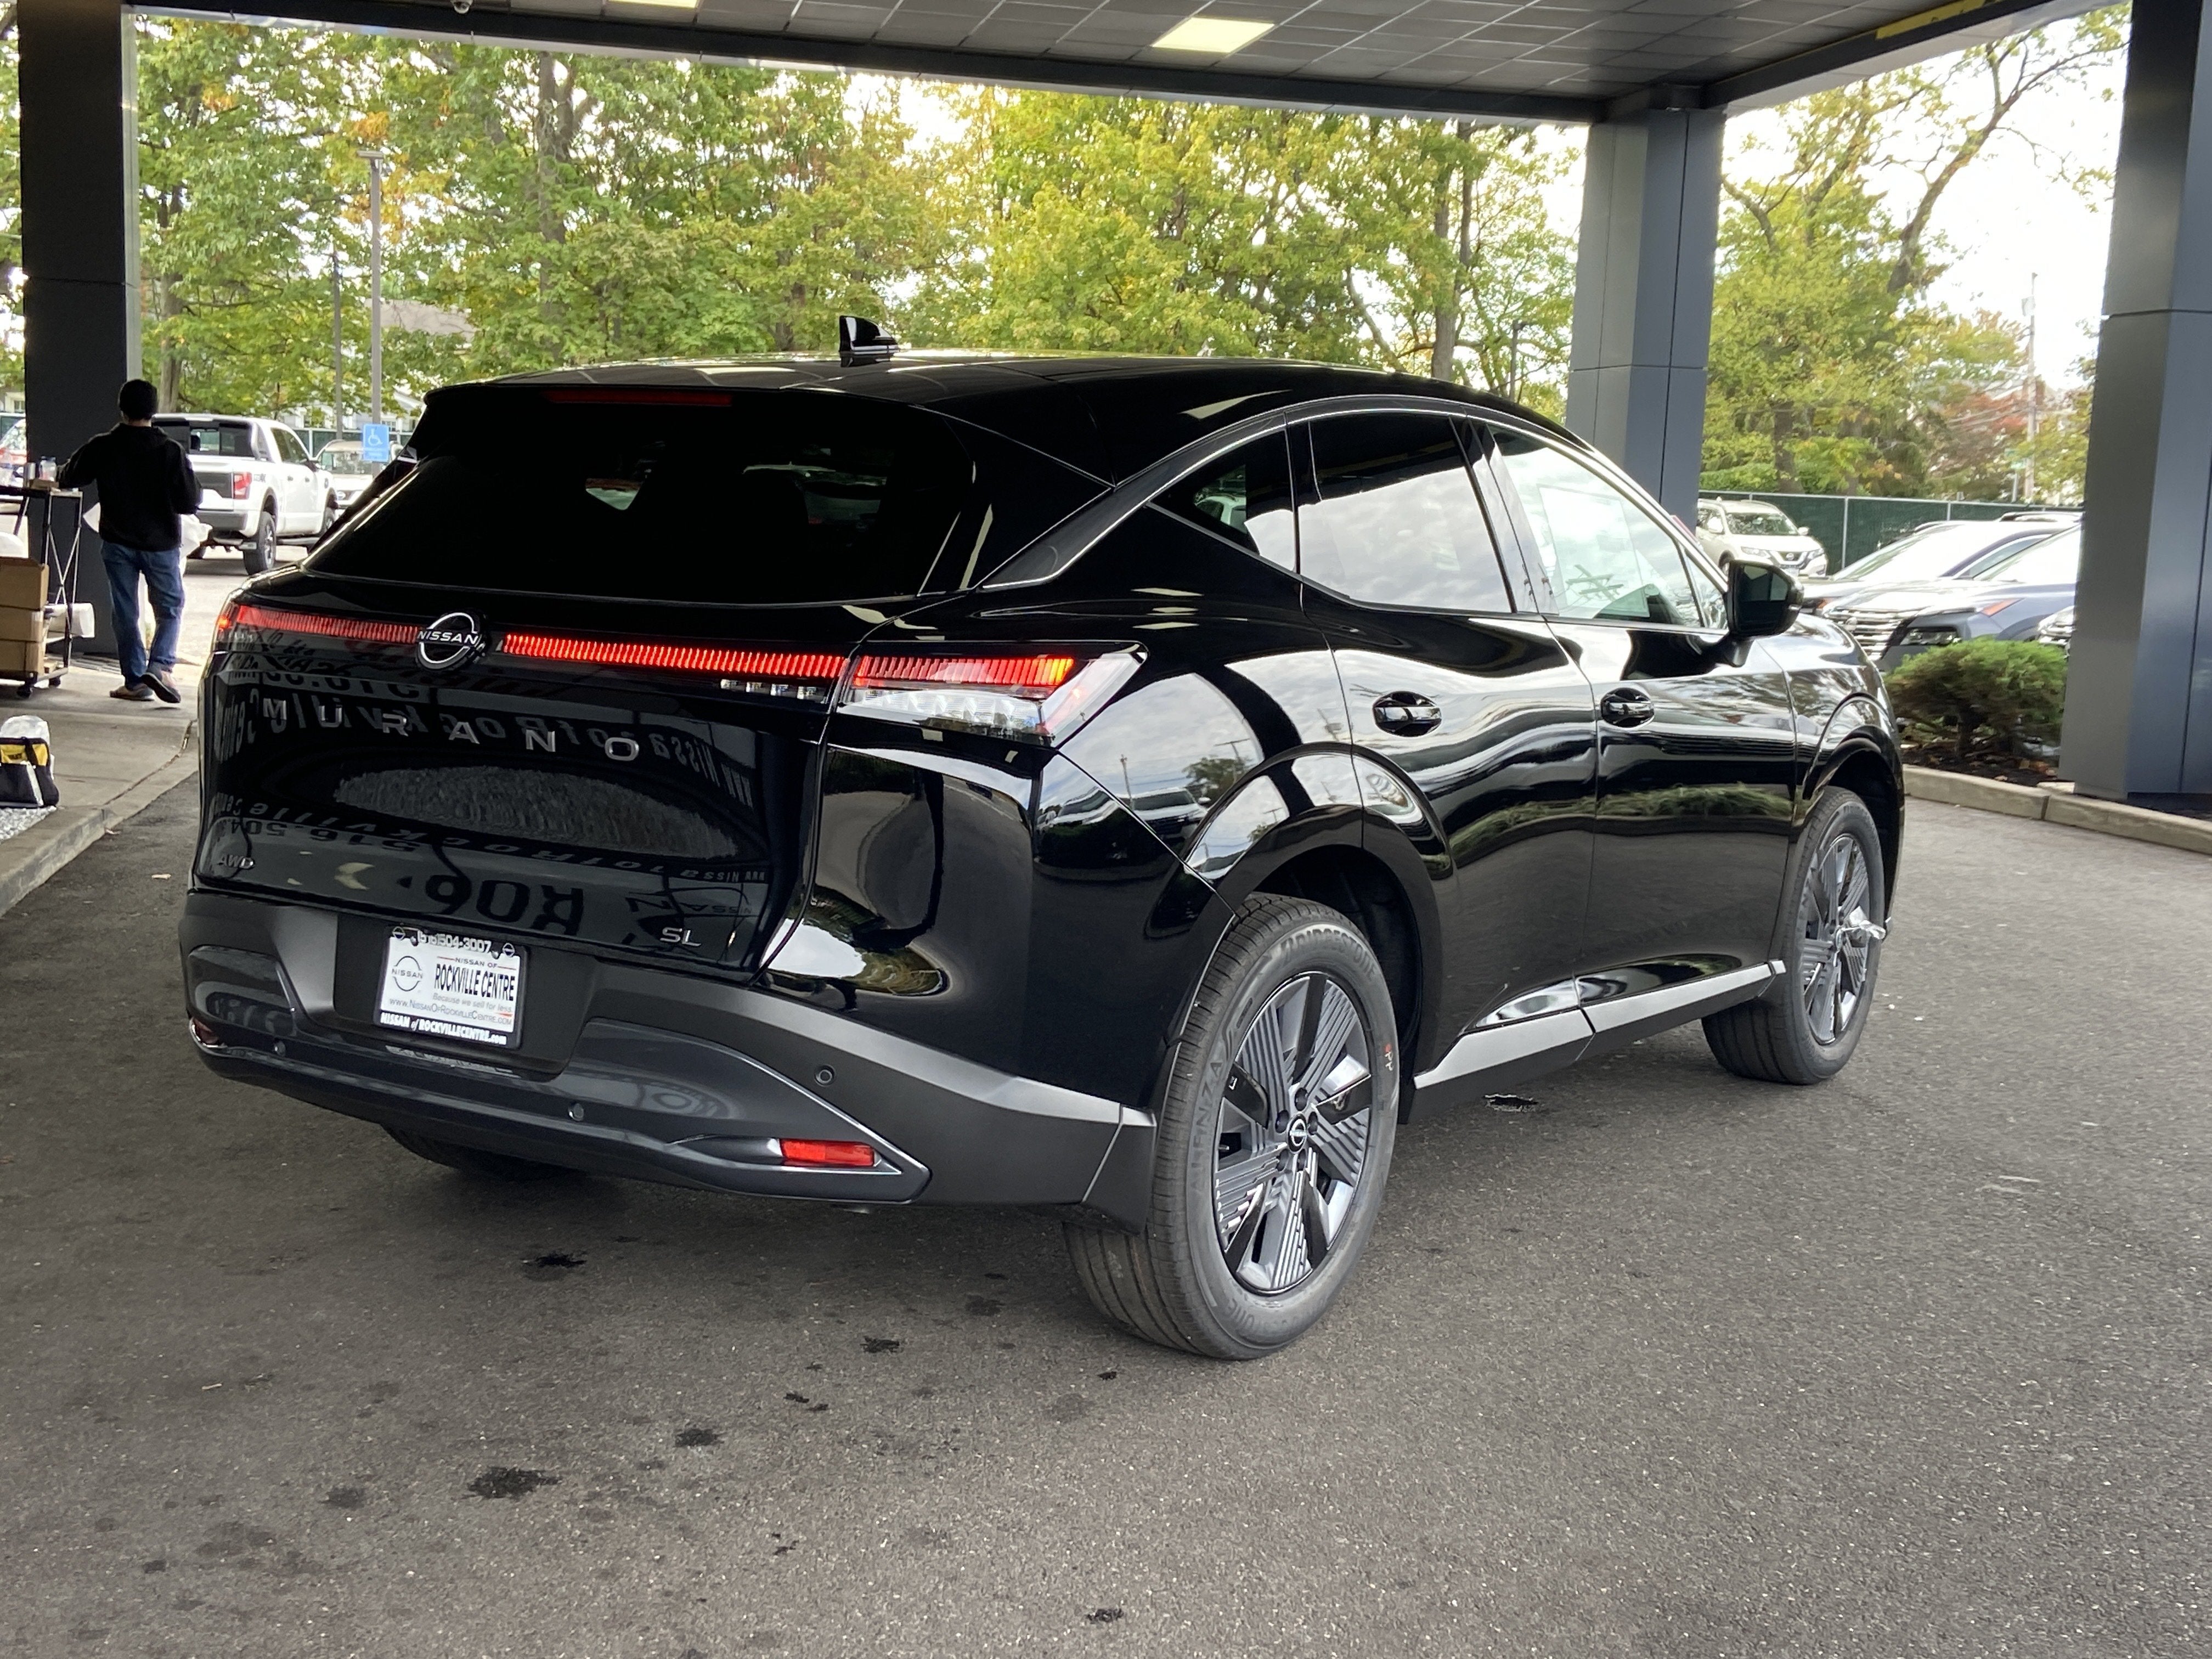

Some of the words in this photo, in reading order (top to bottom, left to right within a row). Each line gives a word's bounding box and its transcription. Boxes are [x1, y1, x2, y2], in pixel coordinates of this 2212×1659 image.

[417, 630, 479, 645] NISSAN
[263, 697, 640, 762] MURANO
[219, 854, 254, 869] AWD
[659, 926, 702, 947] SL
[455, 957, 485, 967] NISSAN
[392, 968, 423, 979] NISSAN
[434, 963, 481, 996] ROCKVILLE
[481, 970, 515, 1002] CENTRE
[432, 992, 460, 1005] Because
[462, 998, 471, 1007] we
[486, 1002, 496, 1011] for
[380, 1012, 410, 1028] NISSAN
